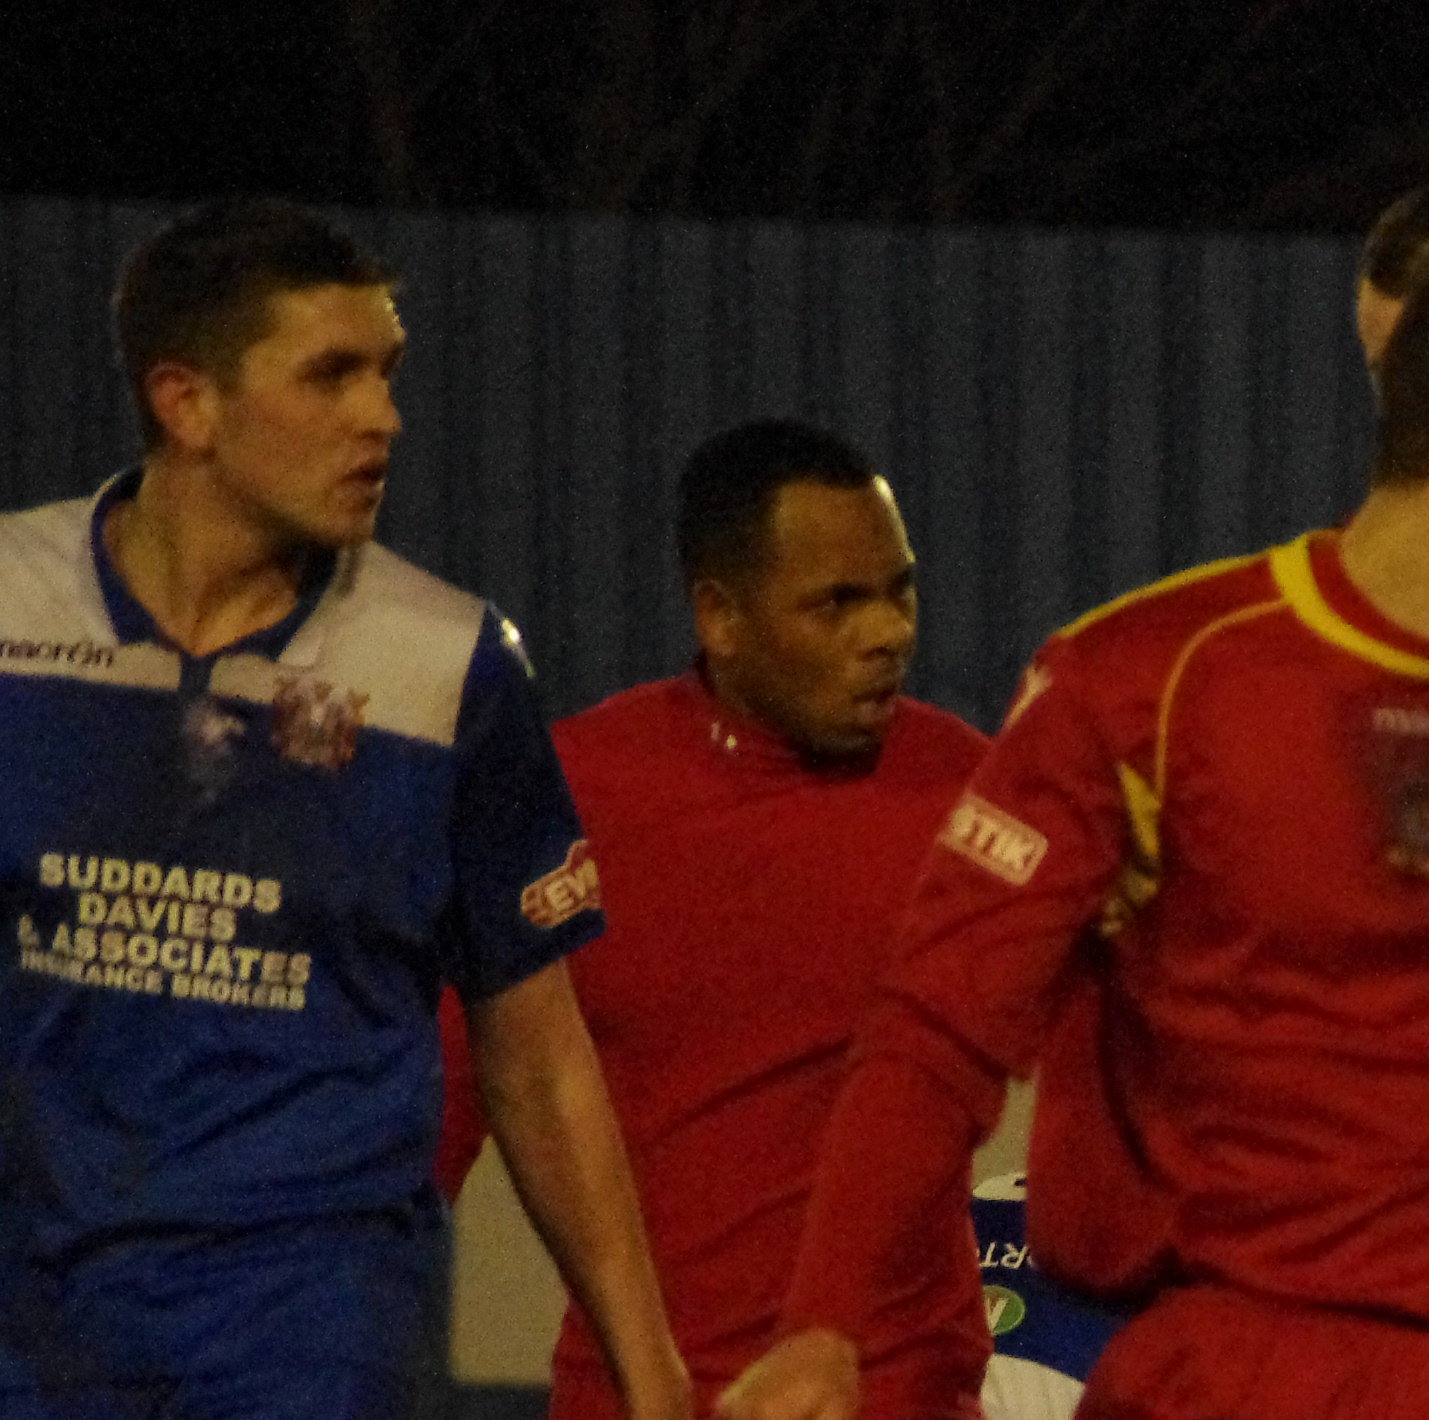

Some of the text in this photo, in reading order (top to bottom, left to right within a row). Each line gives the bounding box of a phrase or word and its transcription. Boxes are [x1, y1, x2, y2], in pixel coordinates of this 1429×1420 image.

[39, 852, 282, 914] SUDDARDS
[78, 892, 238, 942] DAVIES
[52, 922, 312, 985] ASSOCIATES
[169, 973, 306, 1011] BROKERS
